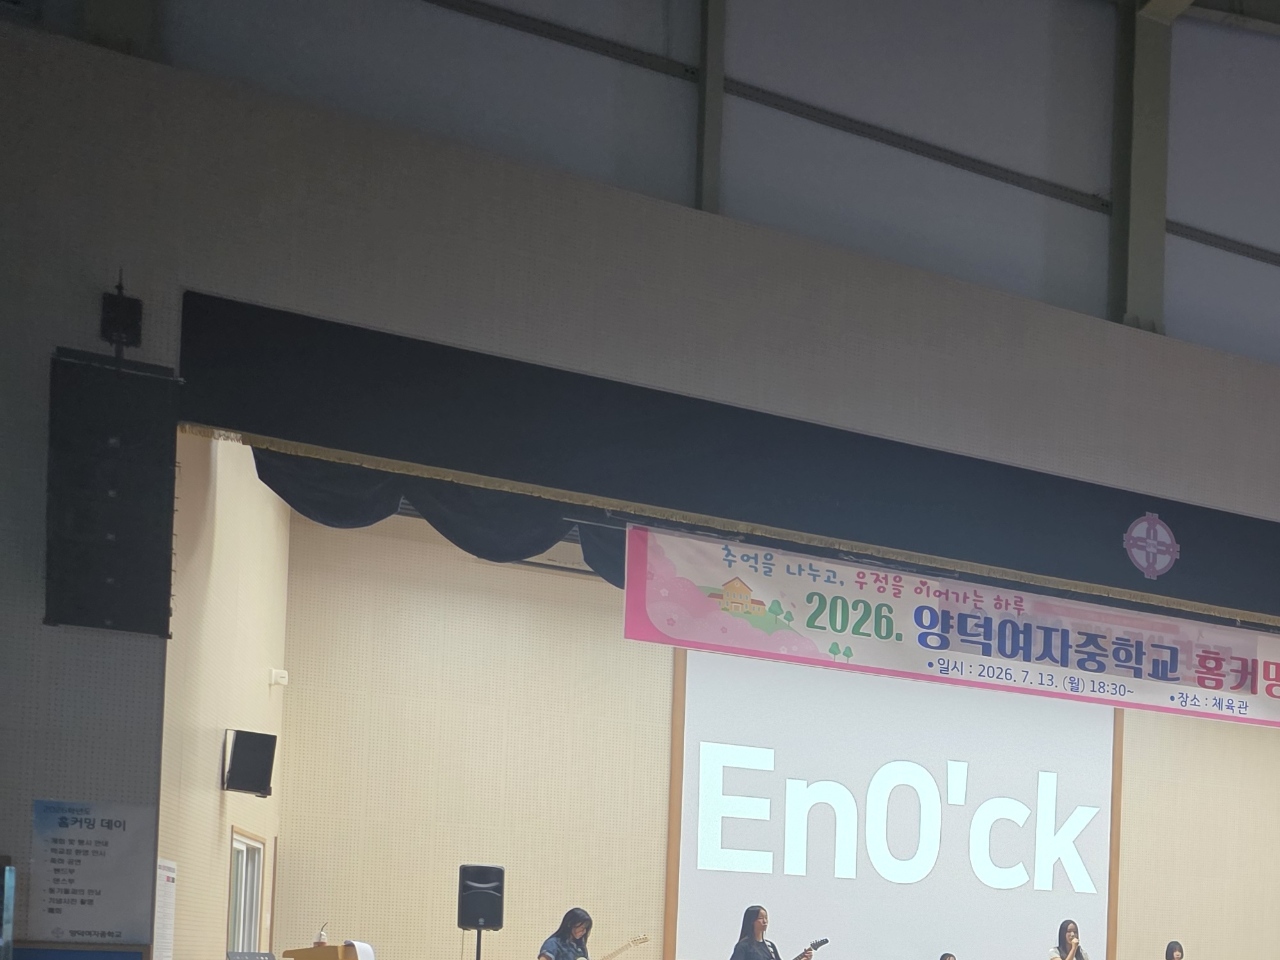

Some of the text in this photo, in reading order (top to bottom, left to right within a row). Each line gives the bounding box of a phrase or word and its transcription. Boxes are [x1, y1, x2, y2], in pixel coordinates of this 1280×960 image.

[721, 544, 1025, 617] 추억을 나누고, 우정을 이어가는 하루
[805, 591, 903, 642] 2026.
[913, 604, 1181, 682] 양덕여자중학교
[937, 657, 964, 676] 일시
[1037, 672, 1058, 688] 13.
[1062, 675, 1086, 694] (월)
[1089, 679, 1135, 698] 18:30~
[1177, 692, 1201, 708] 장소
[1211, 696, 1250, 716] 체육관
[58, 816, 127, 832] 홈커밍 데이
